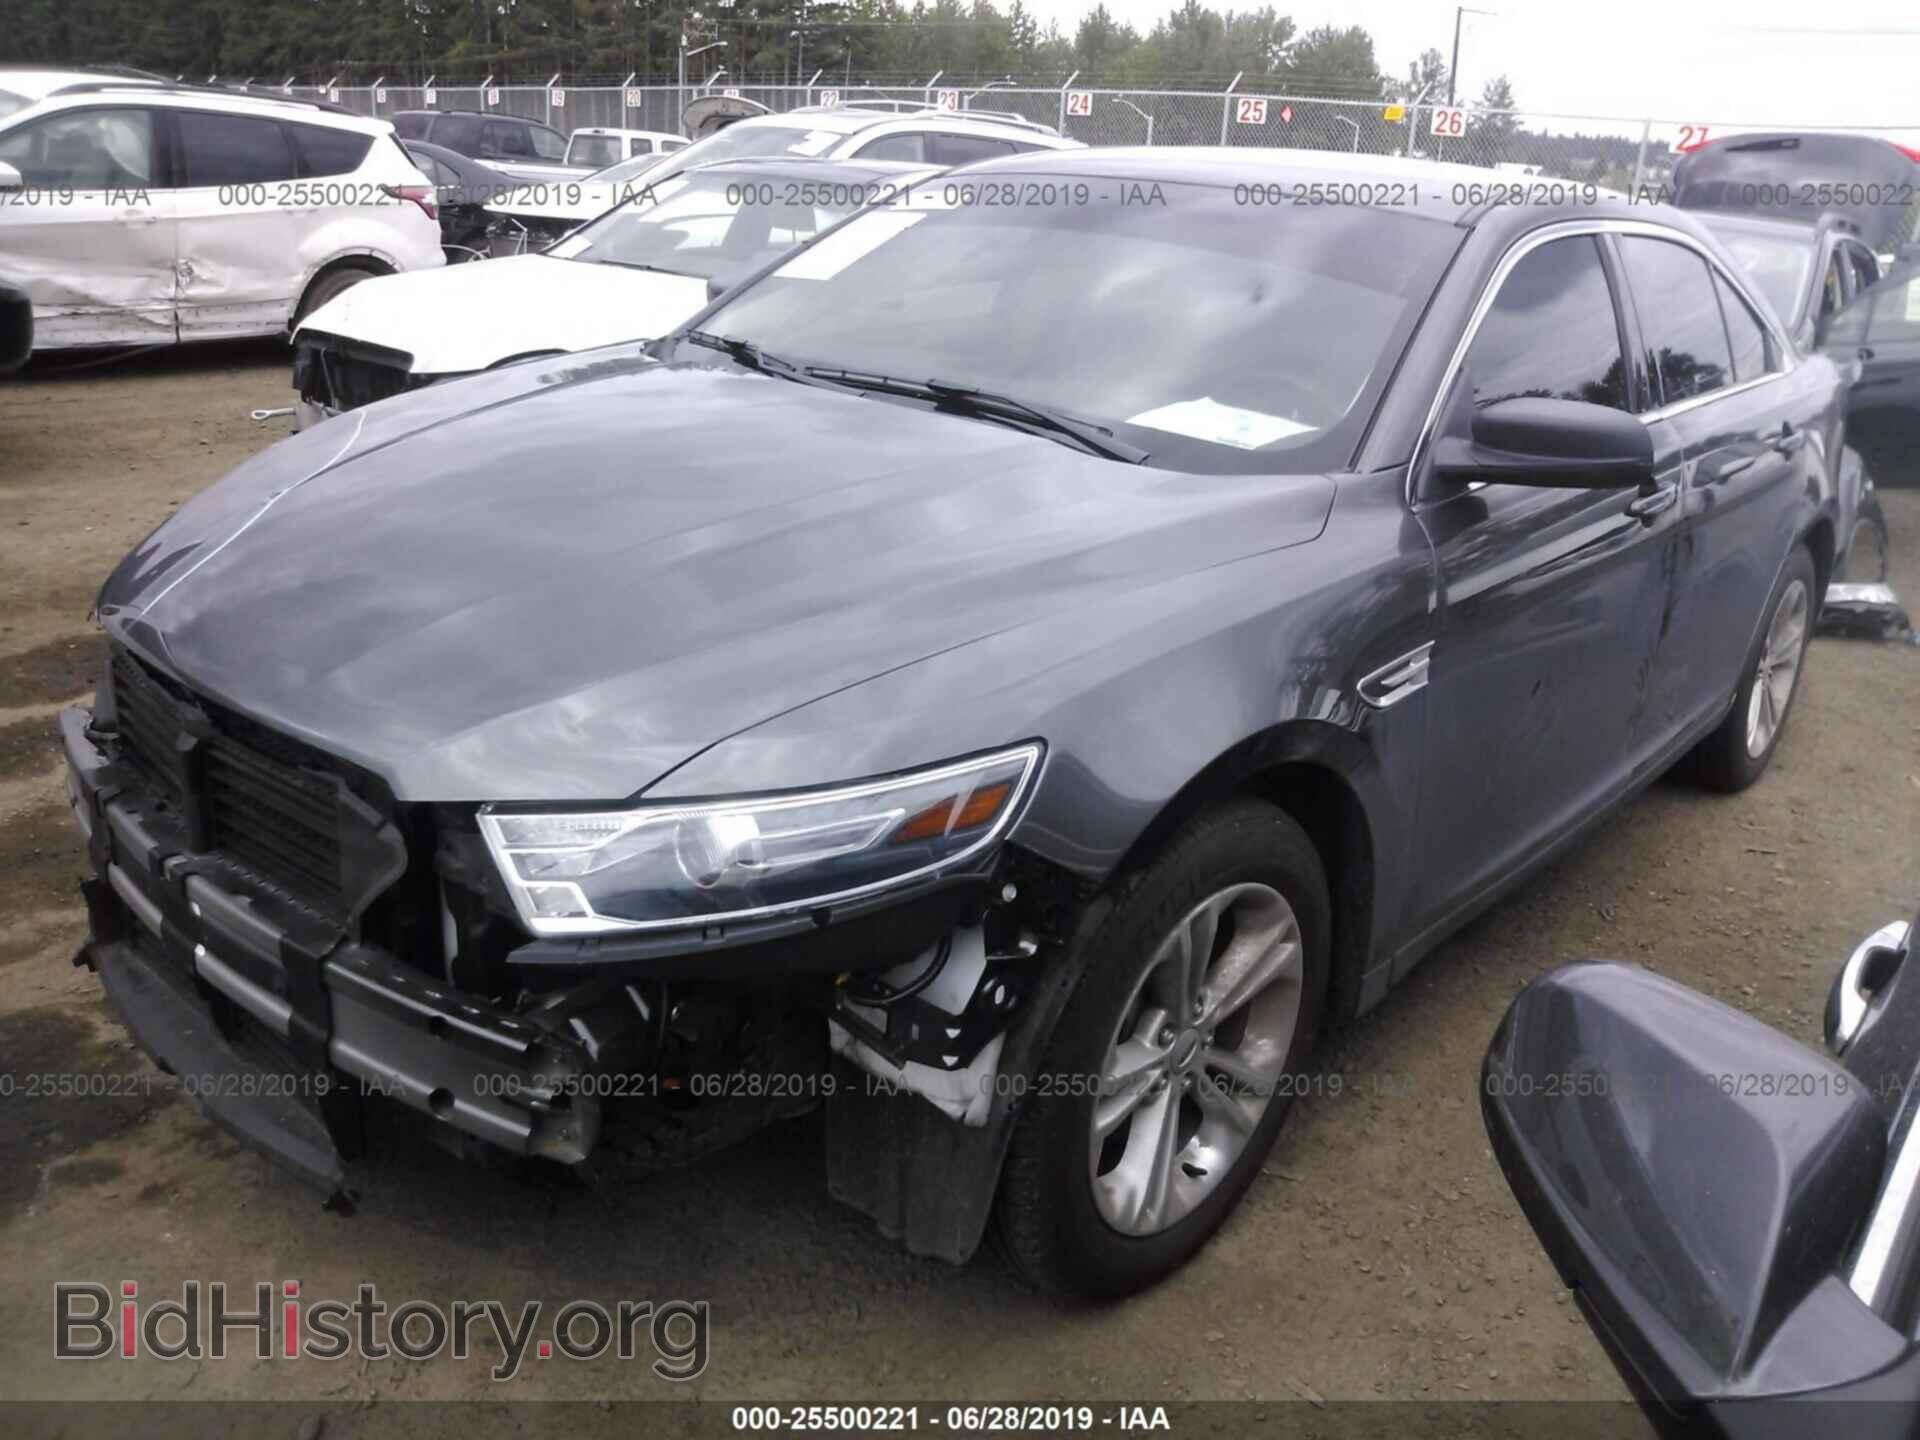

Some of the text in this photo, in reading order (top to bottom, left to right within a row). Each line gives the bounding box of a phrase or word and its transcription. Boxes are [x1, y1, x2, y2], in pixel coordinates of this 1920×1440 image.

[822, 91, 838, 108] 22
[939, 92, 957, 112] 23
[1069, 94, 1089, 114] 24
[1239, 101, 1264, 122] 25
[1434, 110, 1462, 134] 26
[1675, 125, 1709, 152] 27
